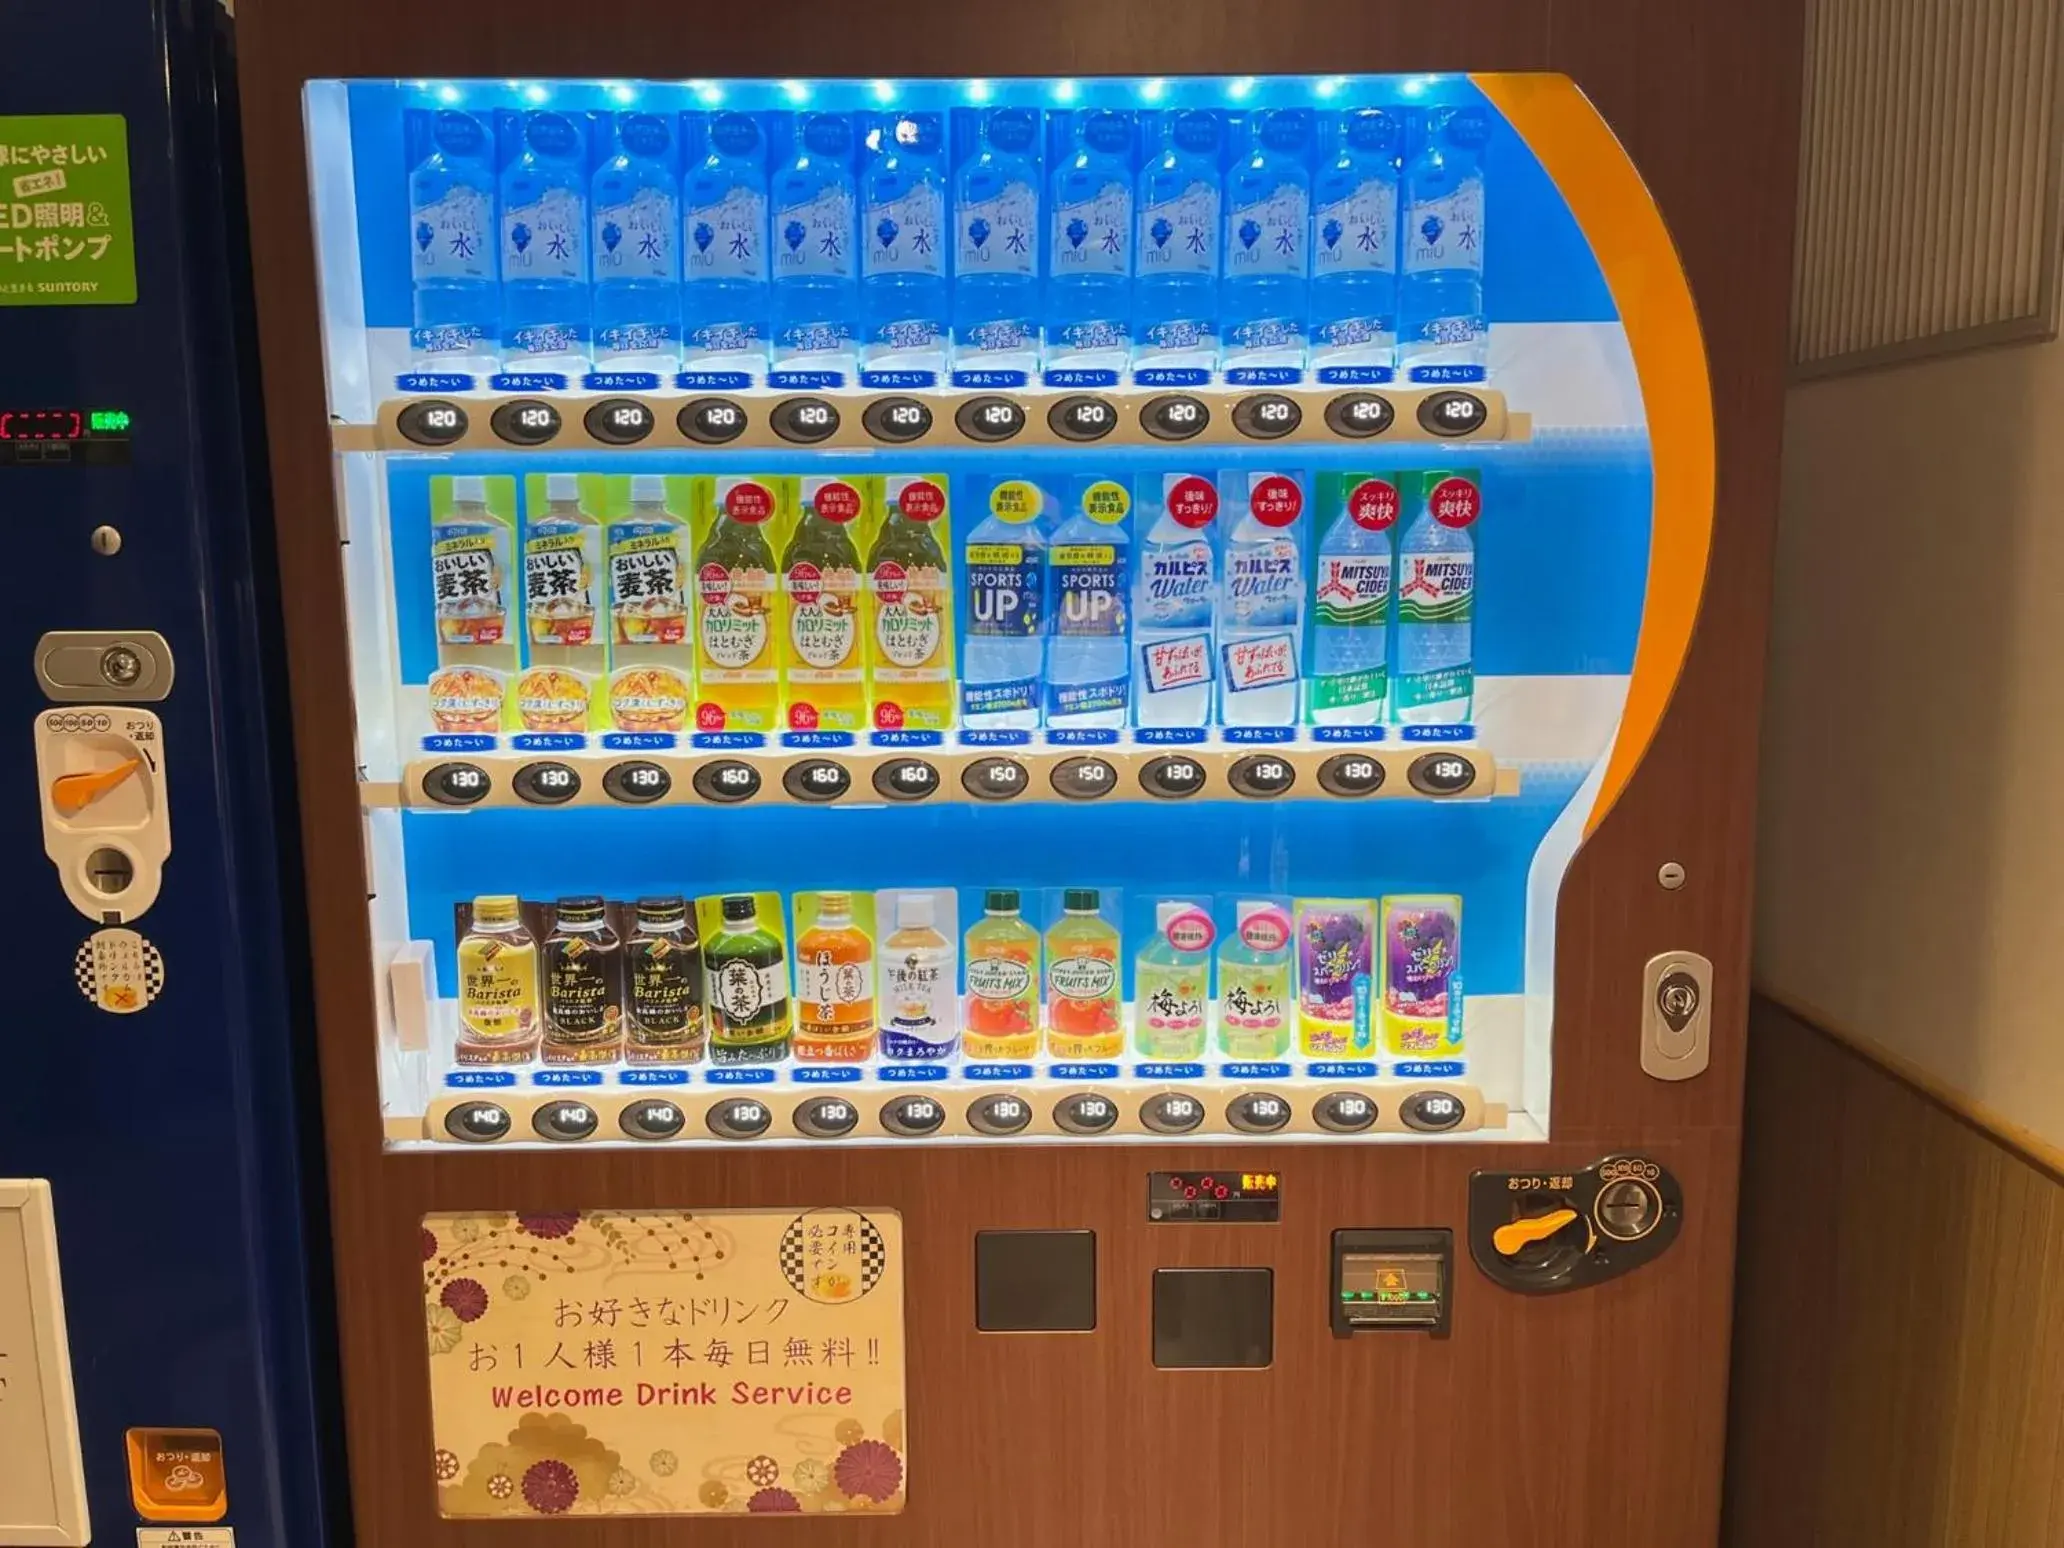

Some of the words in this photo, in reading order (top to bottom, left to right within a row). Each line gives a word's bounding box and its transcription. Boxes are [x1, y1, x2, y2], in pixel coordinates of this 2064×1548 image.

[450, 232, 473, 259] 水
[547, 235, 569, 259] 水
[729, 233, 750, 258] 水
[820, 232, 841, 257] 水
[1006, 229, 1026, 254] 水
[1101, 229, 1120, 254] 水
[1276, 229, 1294, 255] 水
[1358, 226, 1379, 252] 水
[37, 282, 98, 292] SUNTORY
[427, 409, 456, 427] 120
[522, 409, 550, 427] 120
[614, 409, 642, 426] 120
[707, 408, 736, 426] 120
[800, 407, 828, 424] 120
[893, 406, 921, 424] 120
[985, 406, 1012, 424] 120
[1077, 405, 1105, 423] 120
[1168, 404, 1196, 422] 120
[1261, 404, 1288, 421] 120
[1353, 402, 1381, 420] 120
[1445, 401, 1473, 419] 120
[1358, 503, 1393, 521] 爽快
[1438, 500, 1472, 518] 爽快
[435, 555, 485, 572] おいしい
[527, 554, 574, 571] おいしい
[616, 554, 671, 571] おいしい
[1153, 561, 1208, 576] カルピス
[1234, 559, 1291, 574] カルピス
[1425, 563, 1473, 577] MITSUY
[436, 570, 490, 599] 麦茶
[527, 569, 578, 599] 麦茶
[617, 569, 674, 599] 麦茶
[970, 572, 1022, 588] SPORTS
[1062, 573, 1115, 589] SPORTS
[1231, 576, 1294, 597] Water
[1151, 578, 1210, 599] Water
[974, 590, 1019, 621] UP
[1065, 590, 1113, 621] UP
[723, 769, 749, 783] 160
[813, 768, 838, 782] 160
[902, 766, 927, 782] 160
[990, 767, 1016, 781] 150
[1079, 766, 1105, 781] 150
[1167, 765, 1193, 780] 130
[1256, 764, 1282, 779] 130
[1345, 763, 1372, 778] 130
[1435, 762, 1462, 777] 130
[452, 771, 479, 787] 130
[541, 770, 568, 786] 130
[632, 770, 659, 786] 130
[467, 975, 518, 987] 世界一の
[551, 973, 603, 986] 世界一の
[634, 973, 687, 986] 世界一の
[969, 976, 1002, 988] FRUITS
[1007, 976, 1024, 989] MIX
[1054, 976, 1088, 988] FRUITS
[1091, 976, 1110, 988] MIX
[467, 987, 521, 999] Barista
[551, 986, 606, 999] Barista
[635, 986, 690, 999] Barista
[729, 968, 751, 1012] 葉の茶
[560, 1017, 596, 1025] BLACK
[644, 1017, 679, 1025] BLACK
[648, 1108, 673, 1122] 140
[733, 1105, 760, 1120] 130
[821, 1105, 847, 1119] 130
[907, 1103, 934, 1118] 130
[993, 1102, 1020, 1117] 130
[1080, 1102, 1106, 1117] 130
[1166, 1101, 1192, 1116] 130
[1252, 1101, 1279, 1116] 130
[1340, 1100, 1366, 1115] 130
[1426, 1100, 1452, 1114] 130
[473, 1109, 500, 1123] 140
[560, 1109, 587, 1123] 140
[554, 1297, 790, 1328] お好きなドリンク
[492, 1384, 623, 1408] Welcome
[637, 1382, 717, 1406] Drink
[731, 1381, 852, 1406] Service
